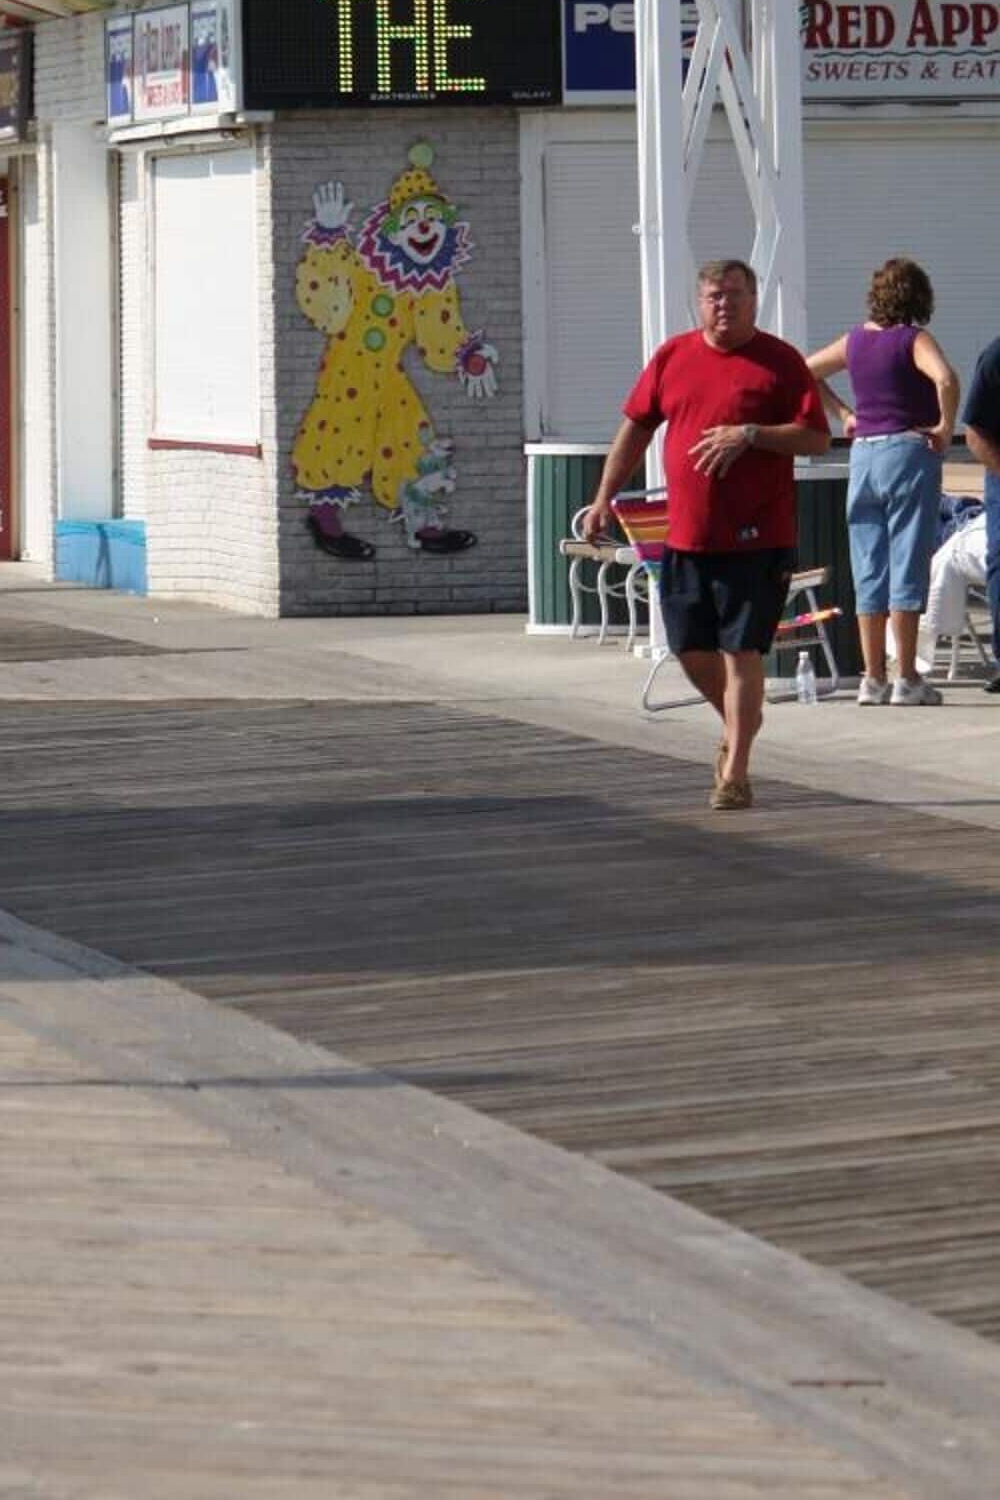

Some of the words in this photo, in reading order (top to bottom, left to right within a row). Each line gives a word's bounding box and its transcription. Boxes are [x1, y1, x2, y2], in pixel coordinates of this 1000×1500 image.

[808, 60, 910, 80] SWEETS
[920, 60, 939, 79] &
[511, 91, 552, 100] GALAXY
